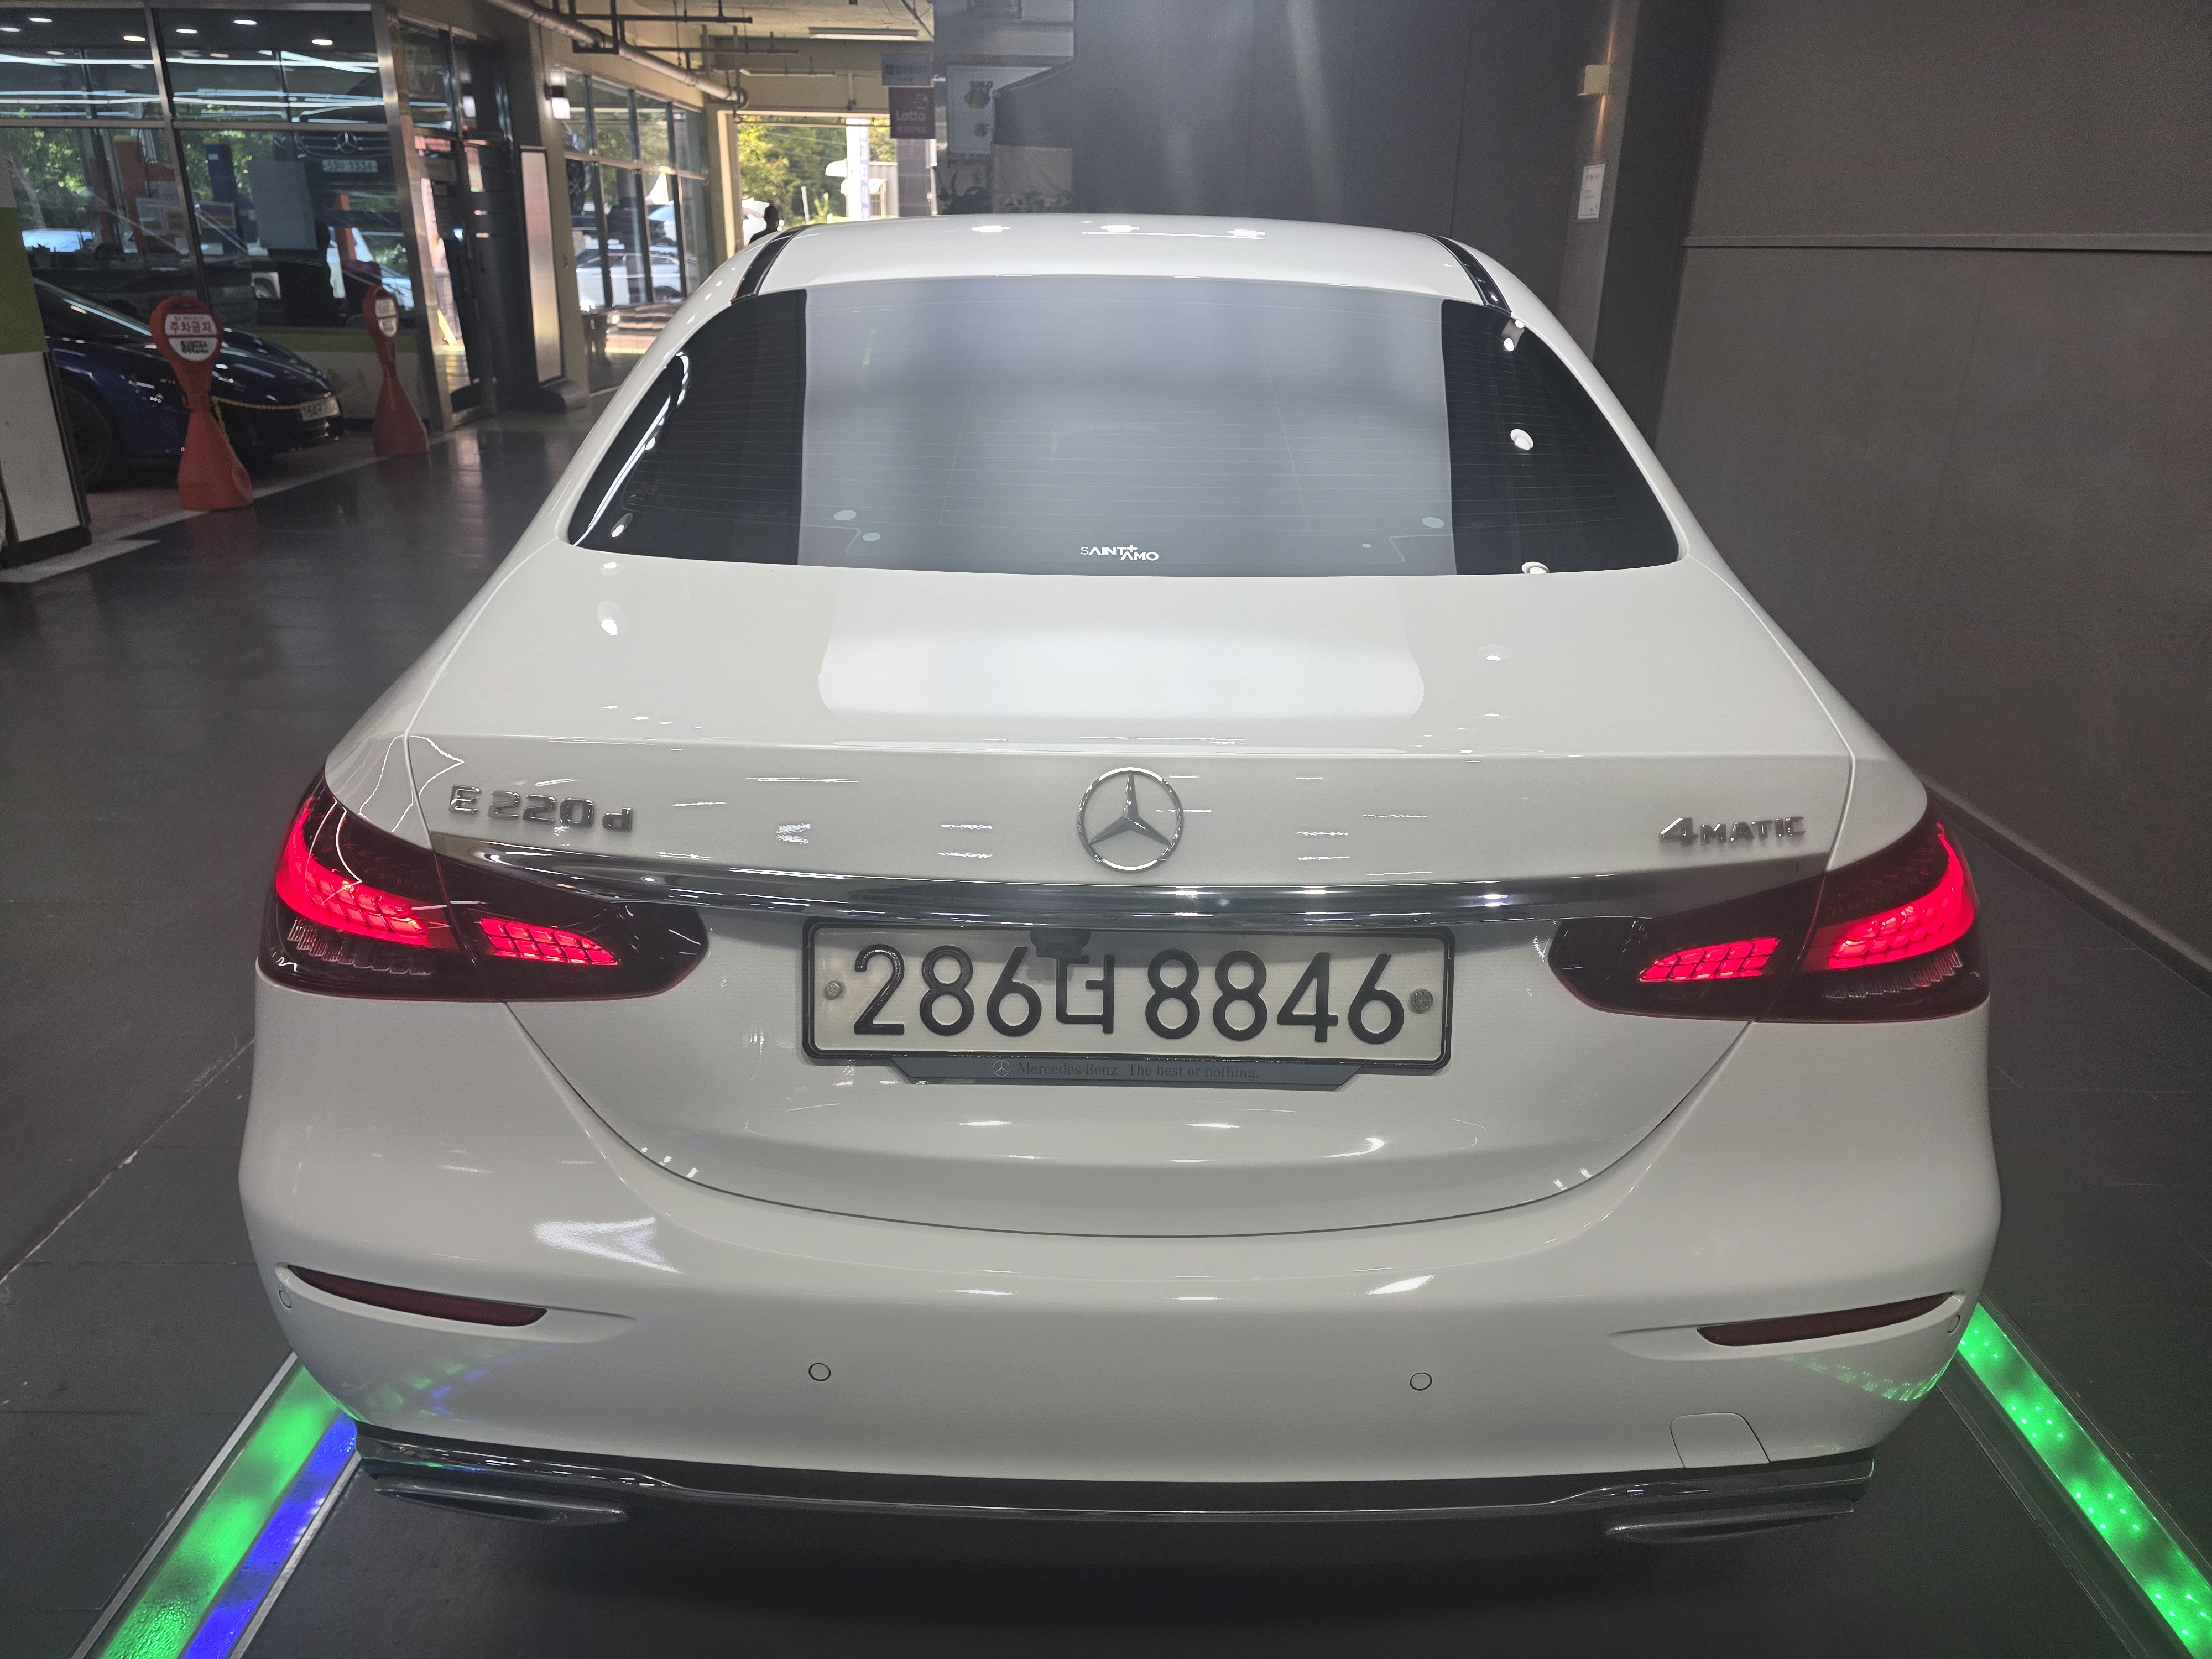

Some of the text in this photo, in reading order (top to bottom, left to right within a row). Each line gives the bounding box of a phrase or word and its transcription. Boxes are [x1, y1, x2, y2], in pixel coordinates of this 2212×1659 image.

[895, 110, 926, 121] Lotto
[170, 321, 212, 333] 주차금지
[1080, 546, 1126, 556] SAINT
[448, 784, 633, 832] E 220 d
[1660, 816, 1806, 846] 4MATIC
[1145, 948, 1405, 1045] 8846
[1018, 1062, 1259, 1081] Mercedes-Benz The best or nothing.
